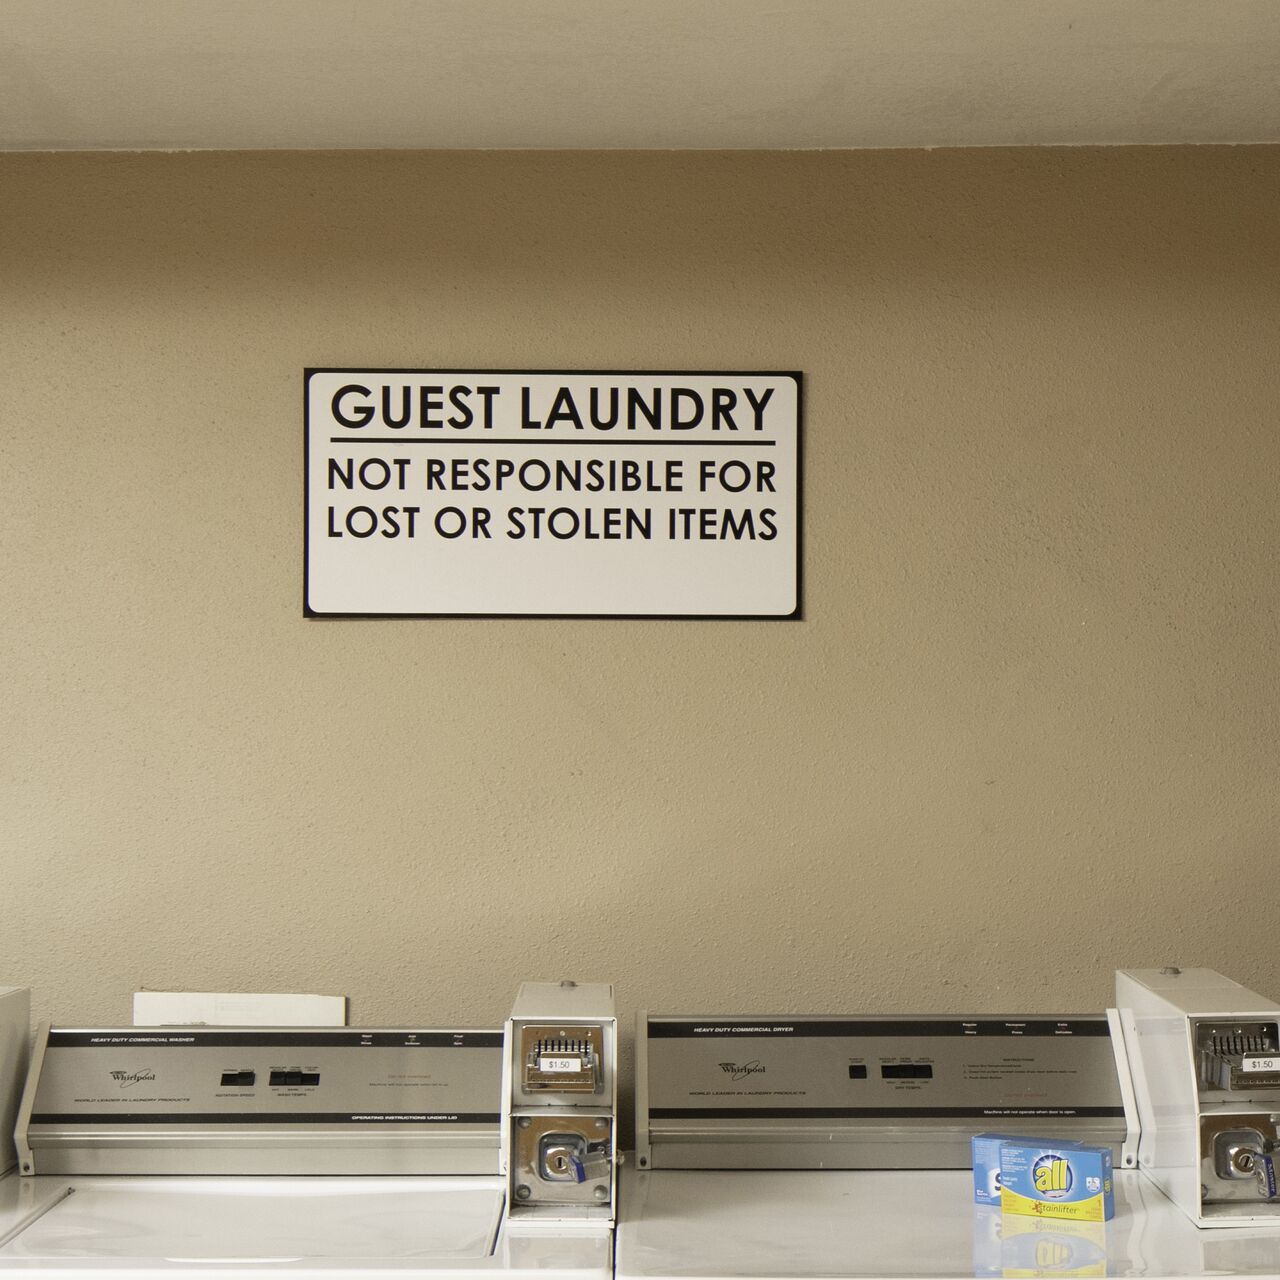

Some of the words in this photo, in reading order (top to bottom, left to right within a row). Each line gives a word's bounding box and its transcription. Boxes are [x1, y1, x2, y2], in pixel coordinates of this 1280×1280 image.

[330, 384, 500, 429] GUEST
[521, 386, 775, 431] LAUNDRY
[327, 457, 411, 490] NOT
[426, 458, 683, 492] RESPONSIBLE
[699, 460, 777, 493] FOR
[327, 505, 420, 539] LOST
[434, 505, 492, 539] OR
[506, 506, 652, 540] STOLEN
[669, 507, 778, 541] ITEMS
[548, 1060, 570, 1069] $1.50
[721, 1065, 766, 1075] Whirlpool
[1251, 1060, 1273, 1069] $1.50
[112, 1073, 156, 1083] Whirlpool
[1035, 1159, 1068, 1192] all
